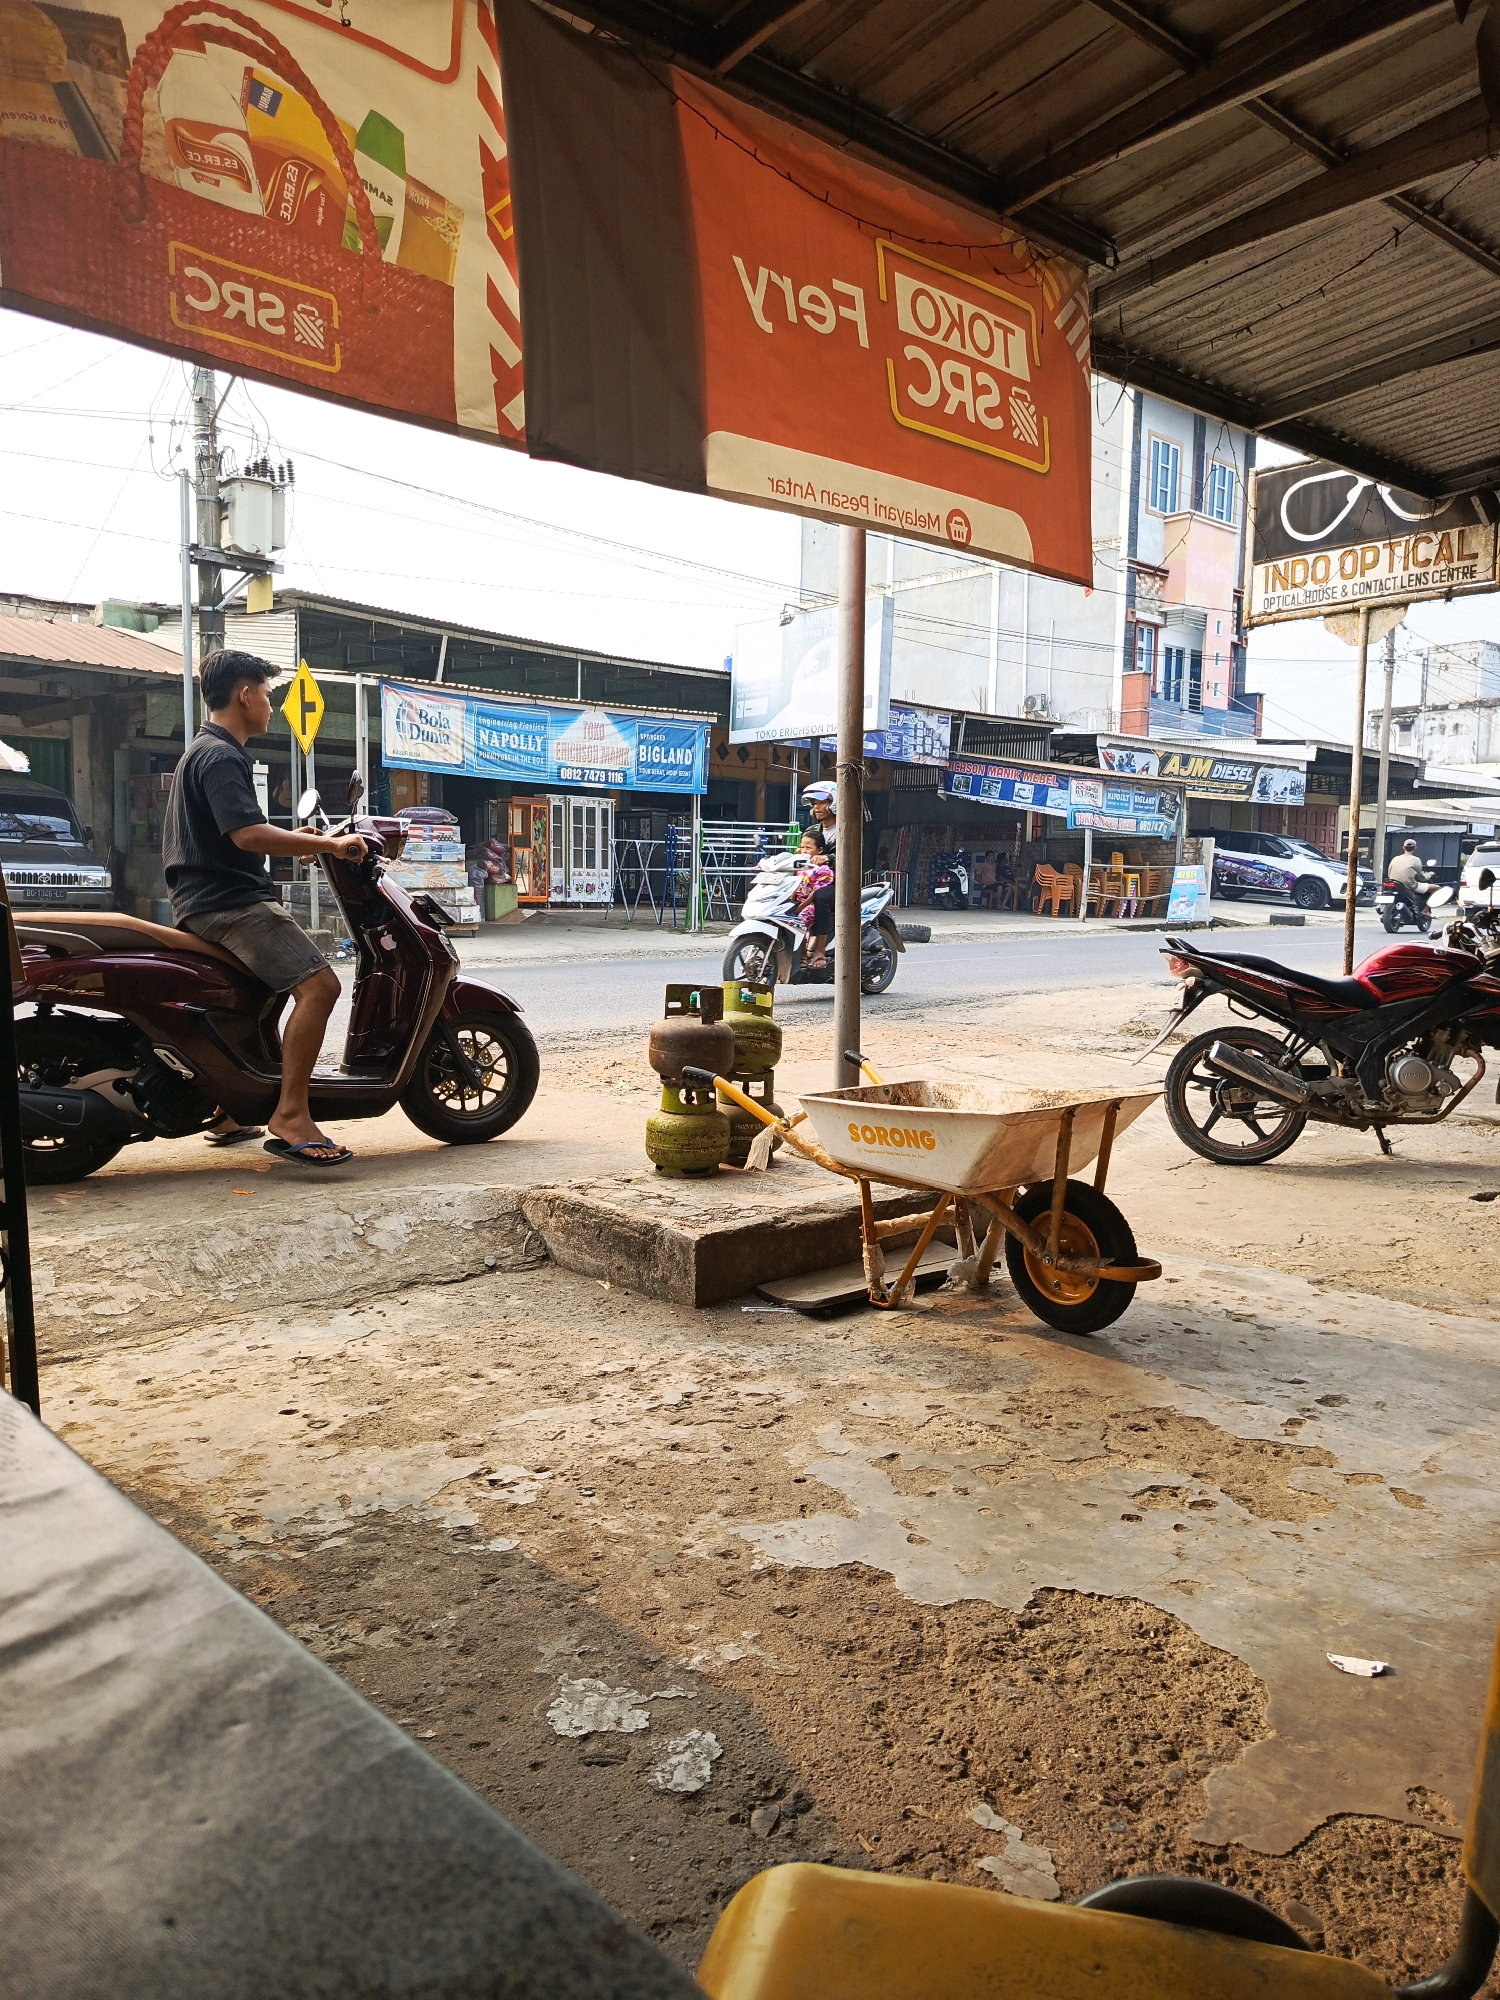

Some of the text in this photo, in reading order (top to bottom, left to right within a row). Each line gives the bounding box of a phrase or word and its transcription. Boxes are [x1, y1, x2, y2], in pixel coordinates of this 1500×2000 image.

[1264, 529, 1479, 594] INDO OPTICAL
[1263, 564, 1478, 610] OPTICAL HOUSE & CONTACT LENS CENTRE
[419, 708, 451, 730] Bola
[409, 722, 451, 745] Dunia
[479, 730, 545, 752] NAPOLLY
[583, 721, 605, 741] TOKO
[756, 723, 838, 740] TOKO ERICHSON MA
[520, 756, 531, 764] THE
[555, 742, 599, 764] ERICHSON
[639, 745, 692, 765] BIGLAND
[560, 768, 624, 783] 0812 7479 1116
[946, 760, 1059, 787] RICHSON MANIK MEBEL
[1163, 755, 1255, 782] AJM DIESEL
[848, 1123, 936, 1151] SORONG
